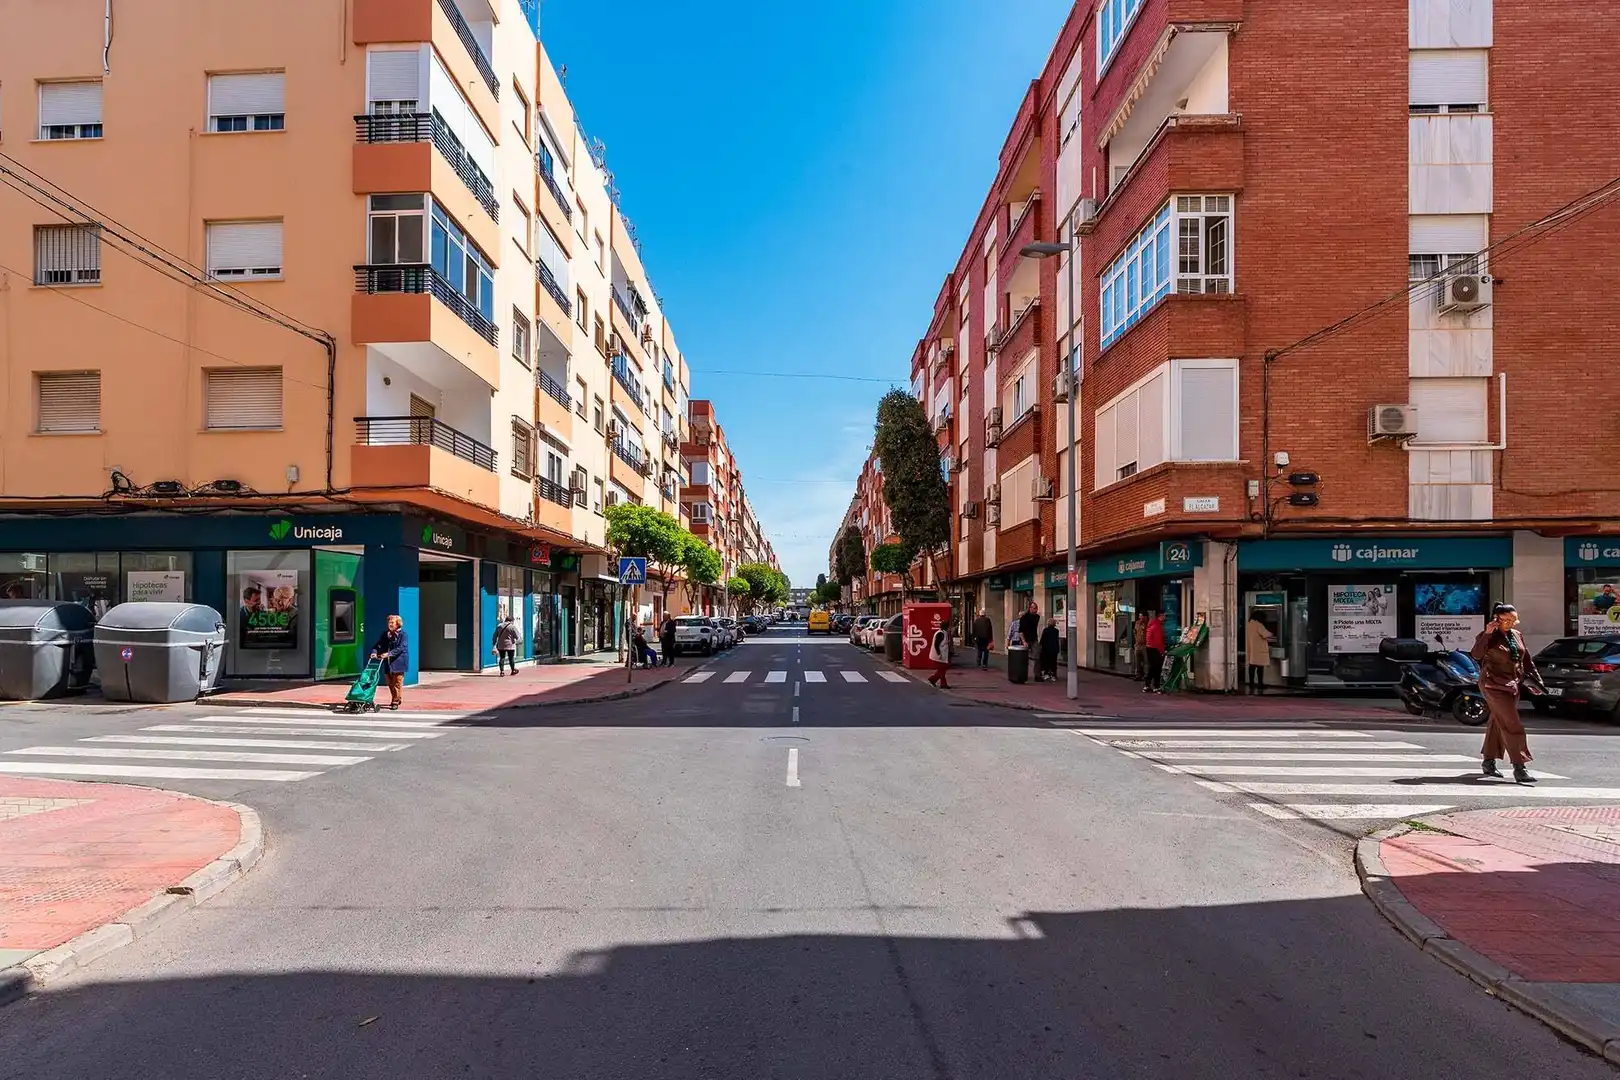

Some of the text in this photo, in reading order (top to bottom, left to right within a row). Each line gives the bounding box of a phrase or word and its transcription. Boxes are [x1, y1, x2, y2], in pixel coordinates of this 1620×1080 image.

[294, 526, 343, 541] Unicaja
[432, 532, 453, 549] Unicaja
[1356, 545, 1419, 562] cajamar
[1125, 560, 1146, 573] cajamar
[248, 611, 289, 626] 450€
